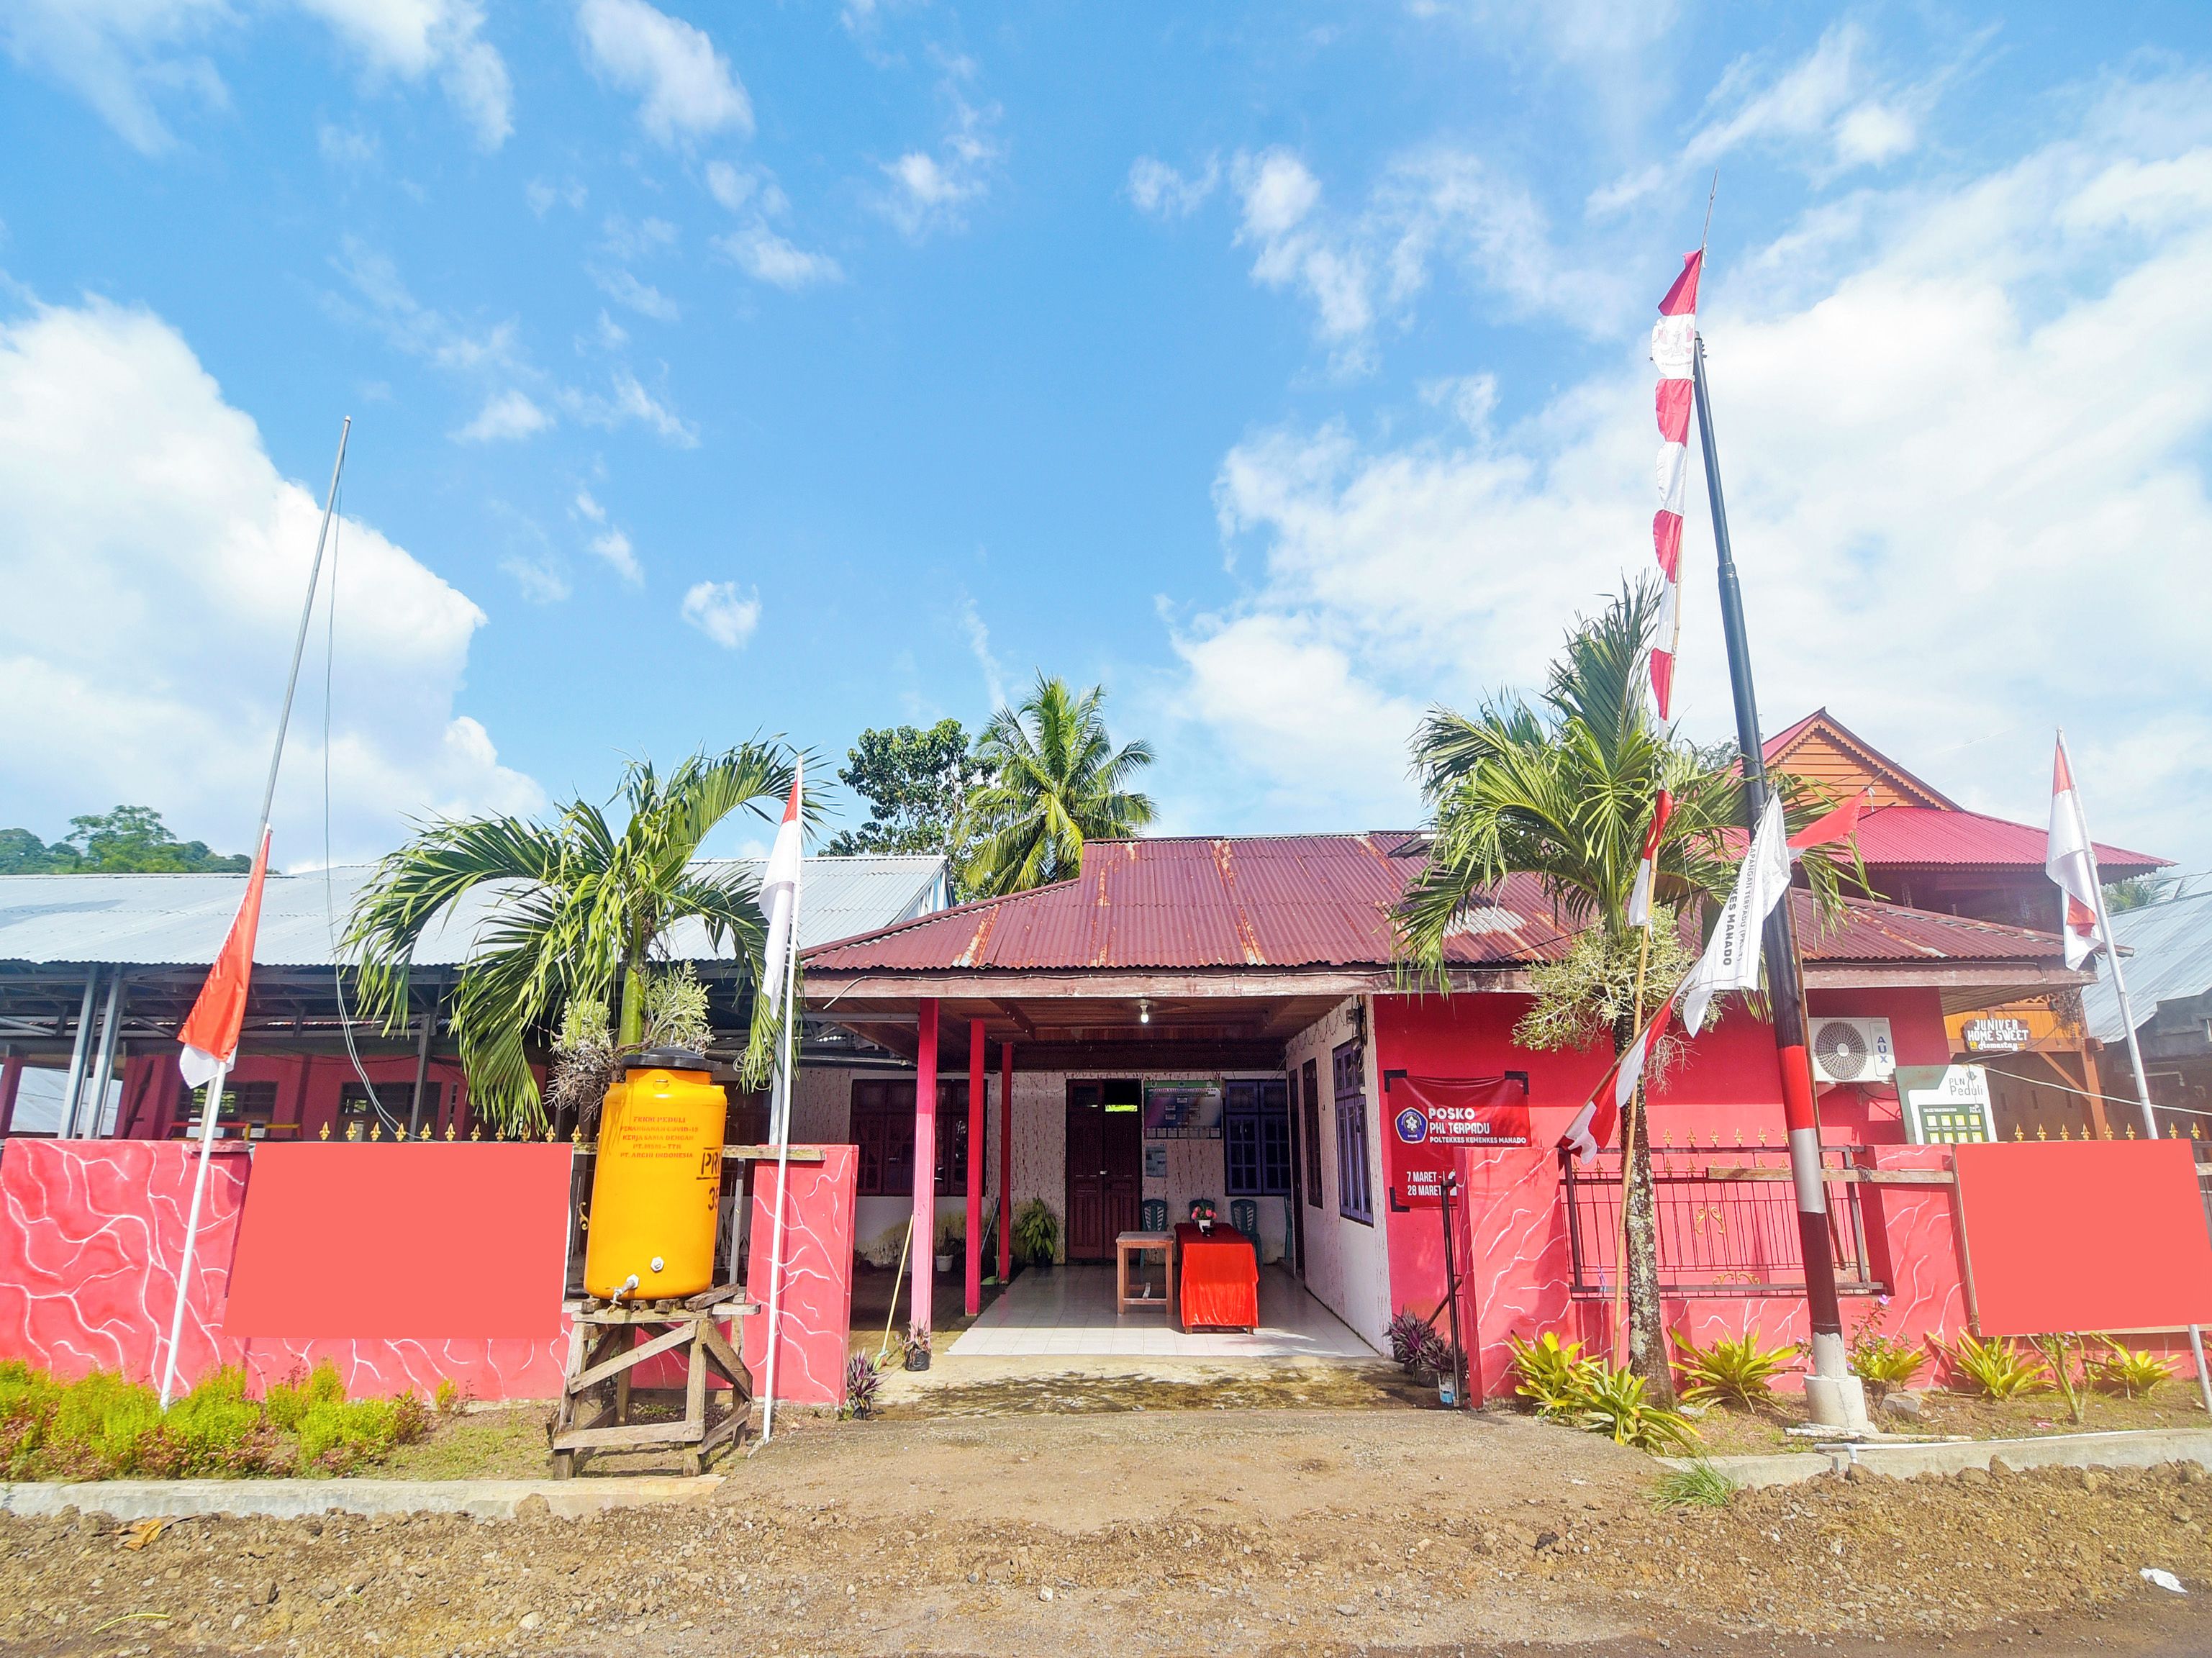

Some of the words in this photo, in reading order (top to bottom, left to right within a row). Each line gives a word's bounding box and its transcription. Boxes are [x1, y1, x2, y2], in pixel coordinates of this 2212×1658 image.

[1745, 843, 1757, 889] LAPANGAN
[1740, 890, 1751, 928] TERPADU
[1723, 914, 1736, 966] MANADO
[1973, 1019, 2018, 1030] JUNIVER
[1967, 1030, 1994, 1041] HOME
[1995, 1029, 2029, 1041] SWEET
[1877, 1036, 1888, 1064] AUX
[1949, 1077, 1965, 1086] PLN
[1949, 1084, 1983, 1096] Peduli
[1428, 1107, 1475, 1120] POSKO
[1448, 1122, 1490, 1134] TERPADU
[1406, 1171, 1411, 1182] 7
[1413, 1171, 1437, 1182] MARET
[1407, 1184, 1417, 1196] 28
[1418, 1184, 1442, 1196] MARET
